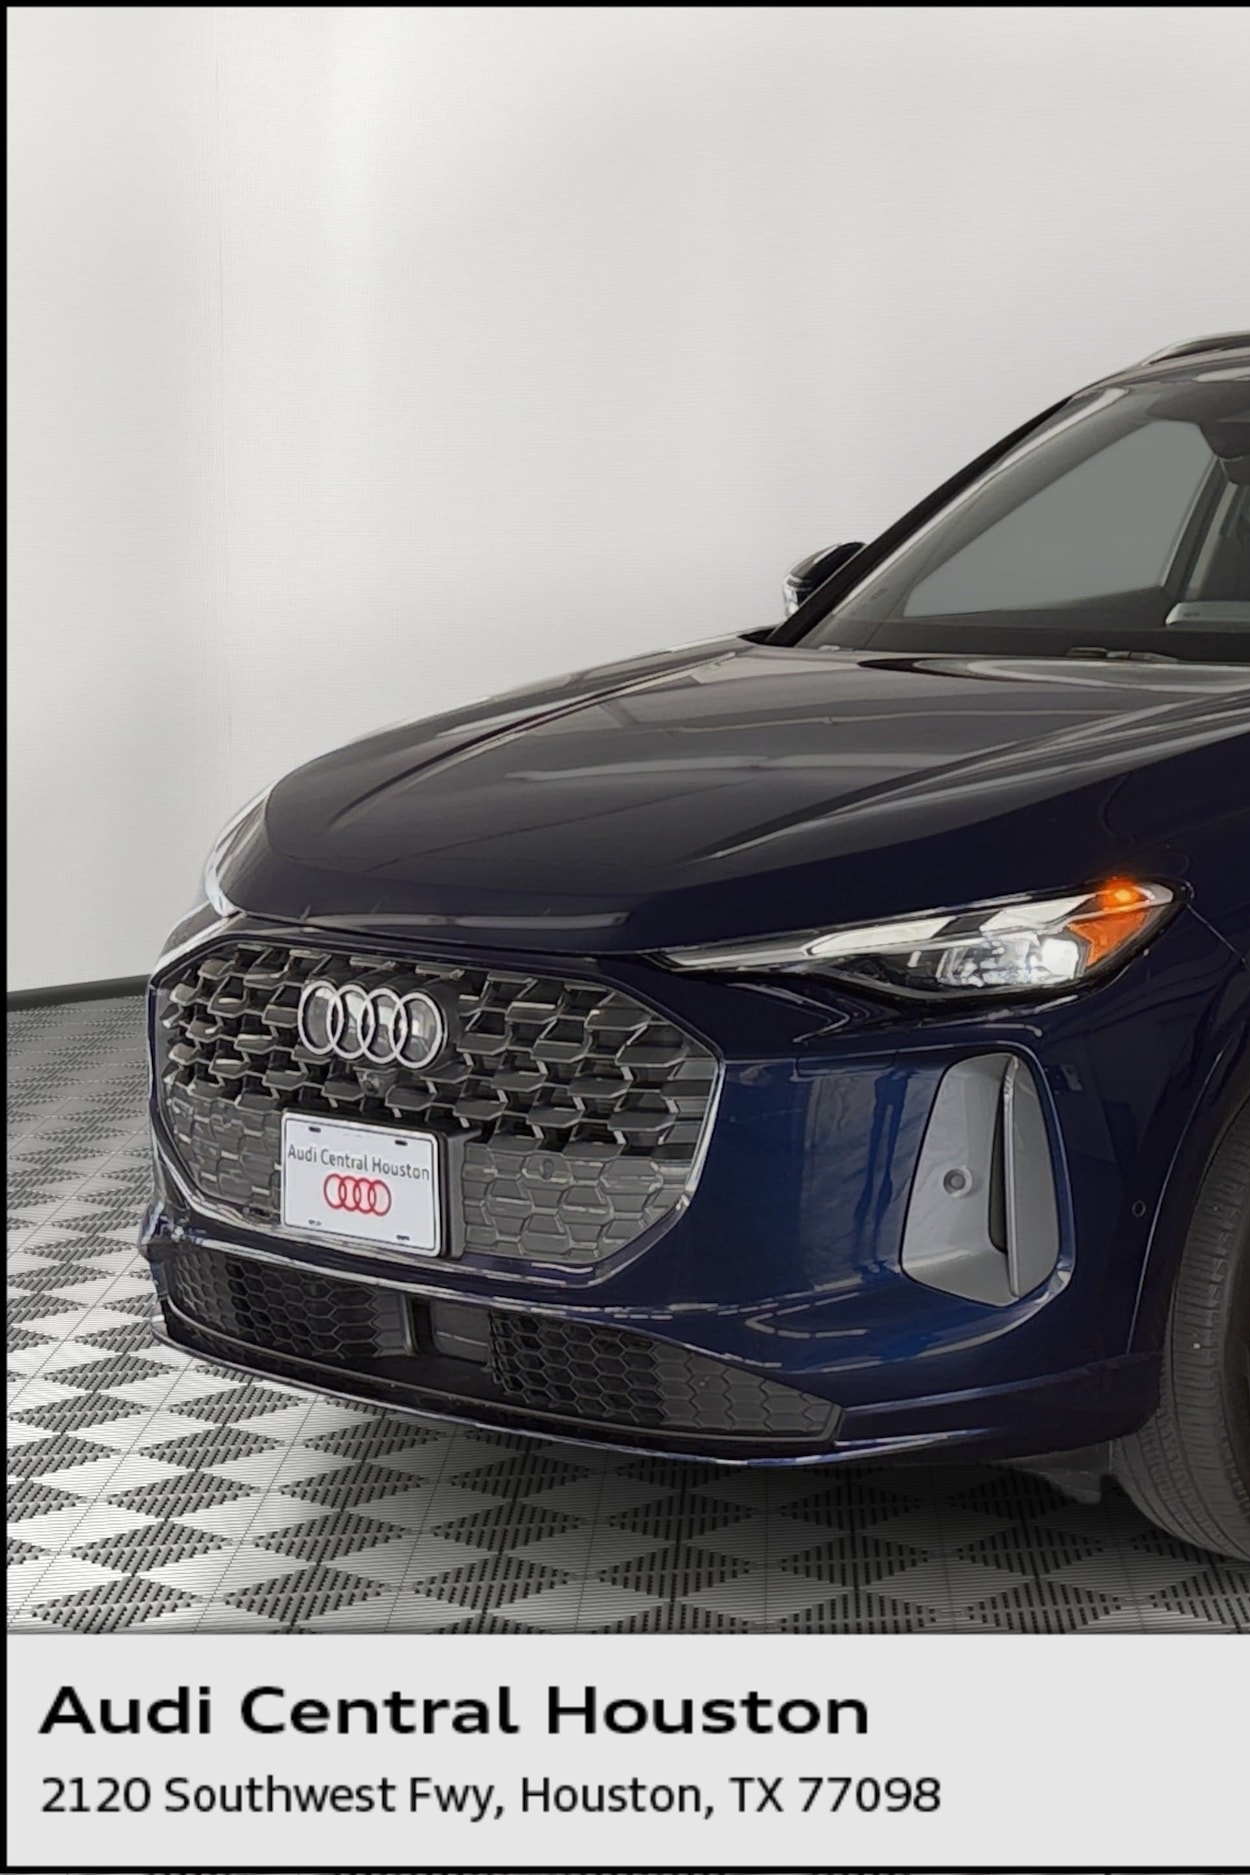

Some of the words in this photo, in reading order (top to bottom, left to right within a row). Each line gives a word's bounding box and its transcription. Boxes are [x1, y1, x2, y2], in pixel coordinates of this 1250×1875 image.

[288, 1143, 318, 1163] Audi
[320, 1148, 369, 1172] Central
[372, 1156, 430, 1181] Houston
